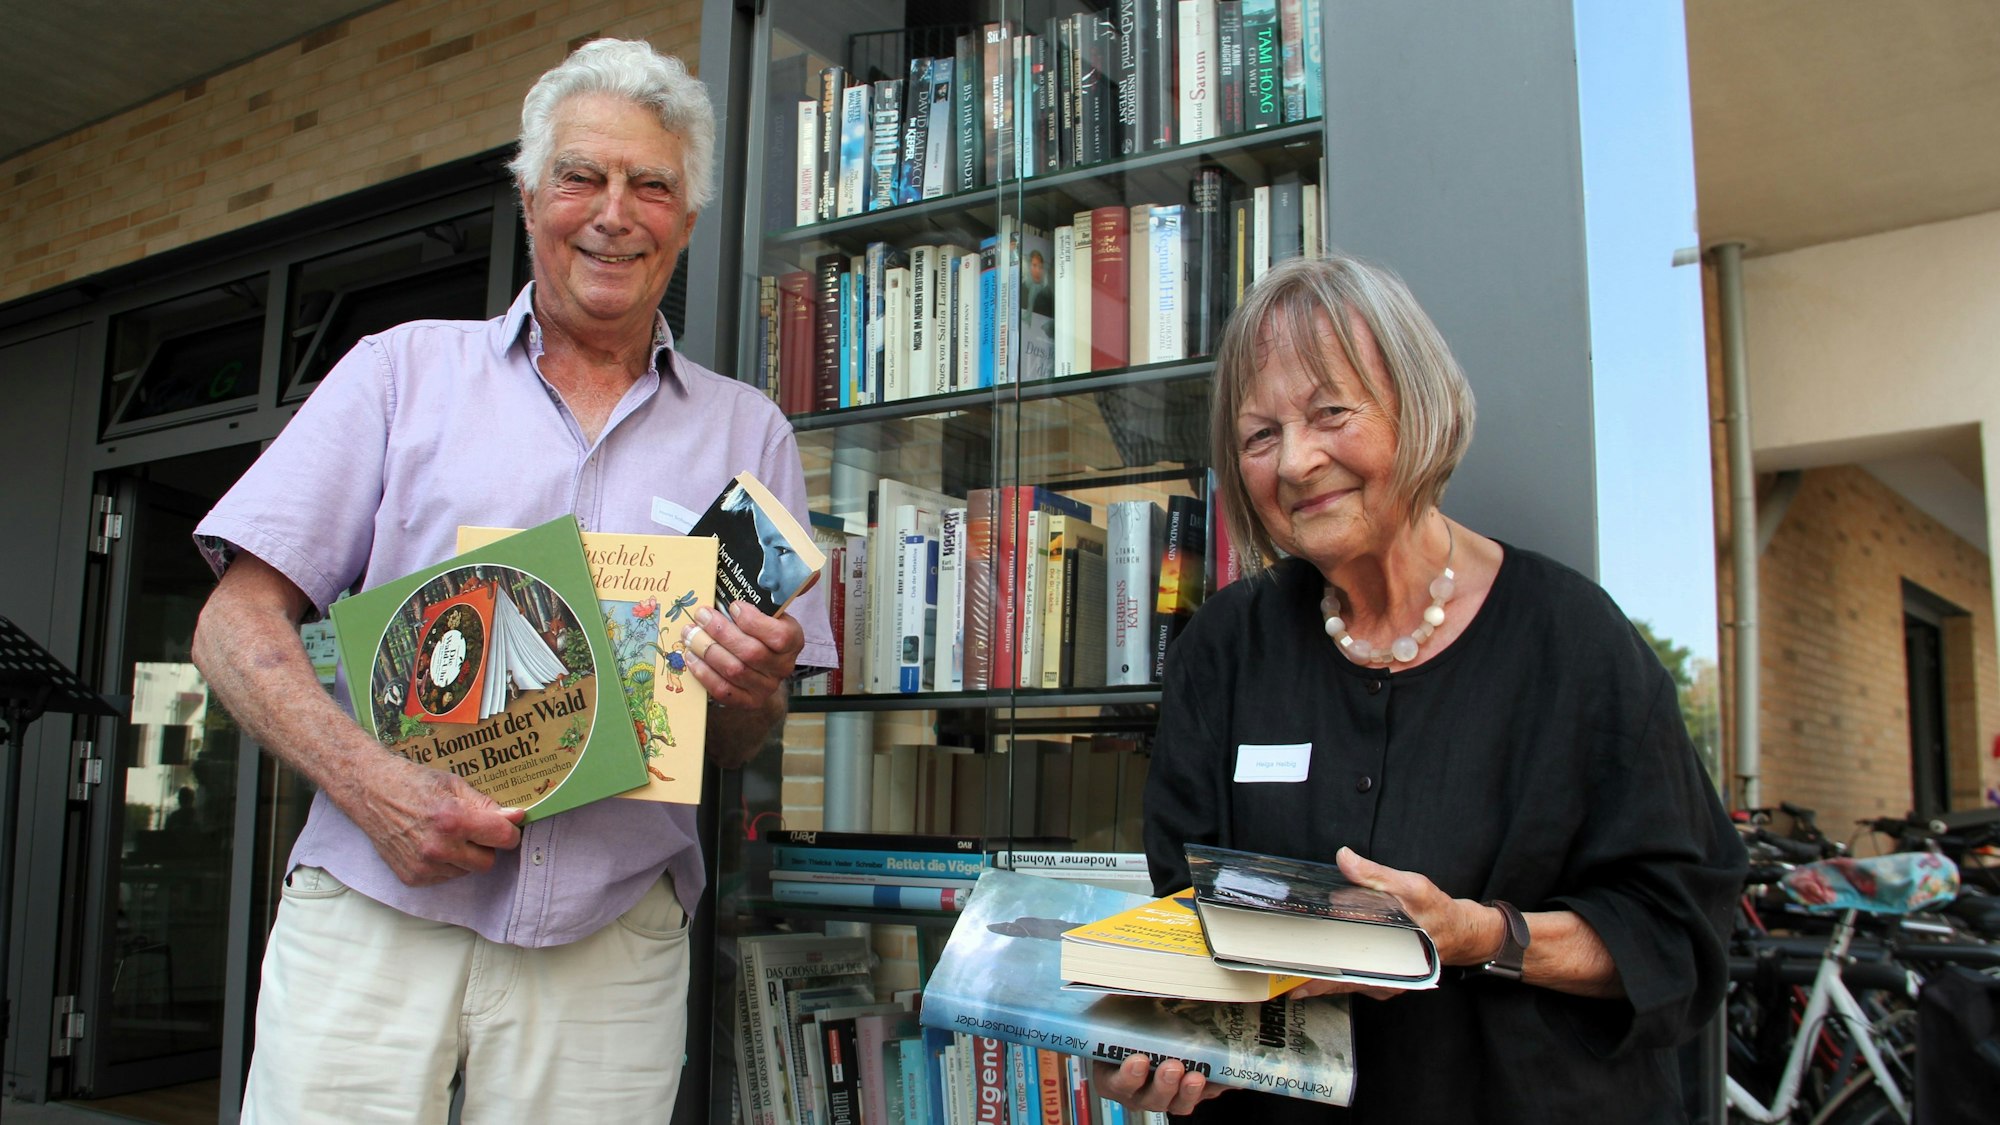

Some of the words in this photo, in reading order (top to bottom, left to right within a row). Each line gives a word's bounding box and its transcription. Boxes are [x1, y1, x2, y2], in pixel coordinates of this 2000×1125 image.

[1121, 2, 1133, 69] McDermid
[1258, 28, 1273, 63] TAMI
[1222, 36, 1232, 76] SLAUGHTER
[1232, 44, 1240, 66] KARIN
[1248, 47, 1257, 66] CRY
[1189, 51, 1206, 100] Sarum
[1248, 70, 1258, 97] WOLF
[963, 84, 972, 101] BIS
[1119, 80, 1127, 124] INTENT
[1127, 74, 1135, 125] INSIDIOUS
[1260, 69, 1274, 114] HOAG
[847, 92, 855, 123] WALTERS
[918, 91, 929, 127] DAVID
[964, 104, 972, 125] IHR
[872, 110, 899, 166] CHILD
[904, 128, 916, 161] KEEPER
[964, 128, 973, 145] SIE
[912, 129, 925, 188] BALDACCI
[964, 148, 973, 190] FINDET
[876, 168, 892, 209] TRIPWIR
[1156, 229, 1174, 284] Reginald
[915, 250, 924, 292] DEUTSCHLAND
[938, 254, 947, 306] Landmann
[914, 293, 923, 320] ANDEREN
[1159, 287, 1174, 312] Hill
[914, 321, 923, 329] IM
[938, 310, 946, 341] Salcia
[913, 331, 922, 351] MUSIK
[938, 344, 946, 360] von
[937, 363, 946, 394] Neues
[1168, 510, 1180, 562] BROADLAND
[711, 532, 735, 567] Rbert
[730, 562, 762, 605] Mawson
[1115, 556, 1140, 564] FRENCH
[592, 567, 672, 593] derland
[853, 580, 862, 598] Das
[1025, 594, 1033, 615] Schloß
[1116, 579, 1126, 648] STERBENS
[1127, 597, 1138, 629] KALT
[854, 604, 862, 646] DANIEL
[1023, 616, 1032, 655] Siebenbrück
[1159, 624, 1168, 649] DAVID
[1155, 651, 1167, 678] BLAKE
[432, 722, 503, 759] kommt
[503, 710, 535, 736] der
[532, 687, 588, 724] Wald
[449, 755, 483, 778] ins
[481, 730, 542, 771] Buch?
[483, 768, 510, 784] Lucht
[510, 757, 540, 775] erzählt
[538, 751, 560, 765] vom
[491, 779, 511, 793] und
[509, 758, 574, 789] Büchermachen
[495, 790, 534, 809] ermann
[957, 840, 973, 849] RVG
[855, 860, 883, 869] Schreiber
[886, 857, 925, 871] Rettet
[927, 859, 946, 872] die
[947, 860, 983, 874] Vögel
[1004, 854, 1056, 866] Wohnstl
[1059, 855, 1117, 867] Moderner
[1081, 930, 1201, 952] SCHUBERT
[744, 954, 759, 1009] BLITZREZEPTE
[765, 965, 783, 979] DAS
[785, 964, 818, 978] GROSSE
[821, 962, 844, 974] BUCH
[739, 990, 750, 1023] KOCHEN
[751, 1010, 761, 1027] DER
[743, 1024, 753, 1044] VOM
[754, 1029, 764, 1053] BUCH
[955, 1013, 1049, 1042] Achttausender
[1051, 1033, 1063, 1044] 14
[1066, 1036, 1088, 1050] Alle
[746, 1045, 757, 1069] BUCH
[1014, 1052, 1024, 1078] erste
[748, 1071, 759, 1091] NEUE
[758, 1056, 770, 1088] GROSSE
[977, 1038, 998, 1125] Jugend
[1219, 1065, 1274, 1087] Messner
[751, 1092, 761, 1110] DAS
[761, 1089, 772, 1106] DAS
[1016, 1083, 1026, 1112] Meine
[1276, 1077, 1333, 1098] Reinhold
